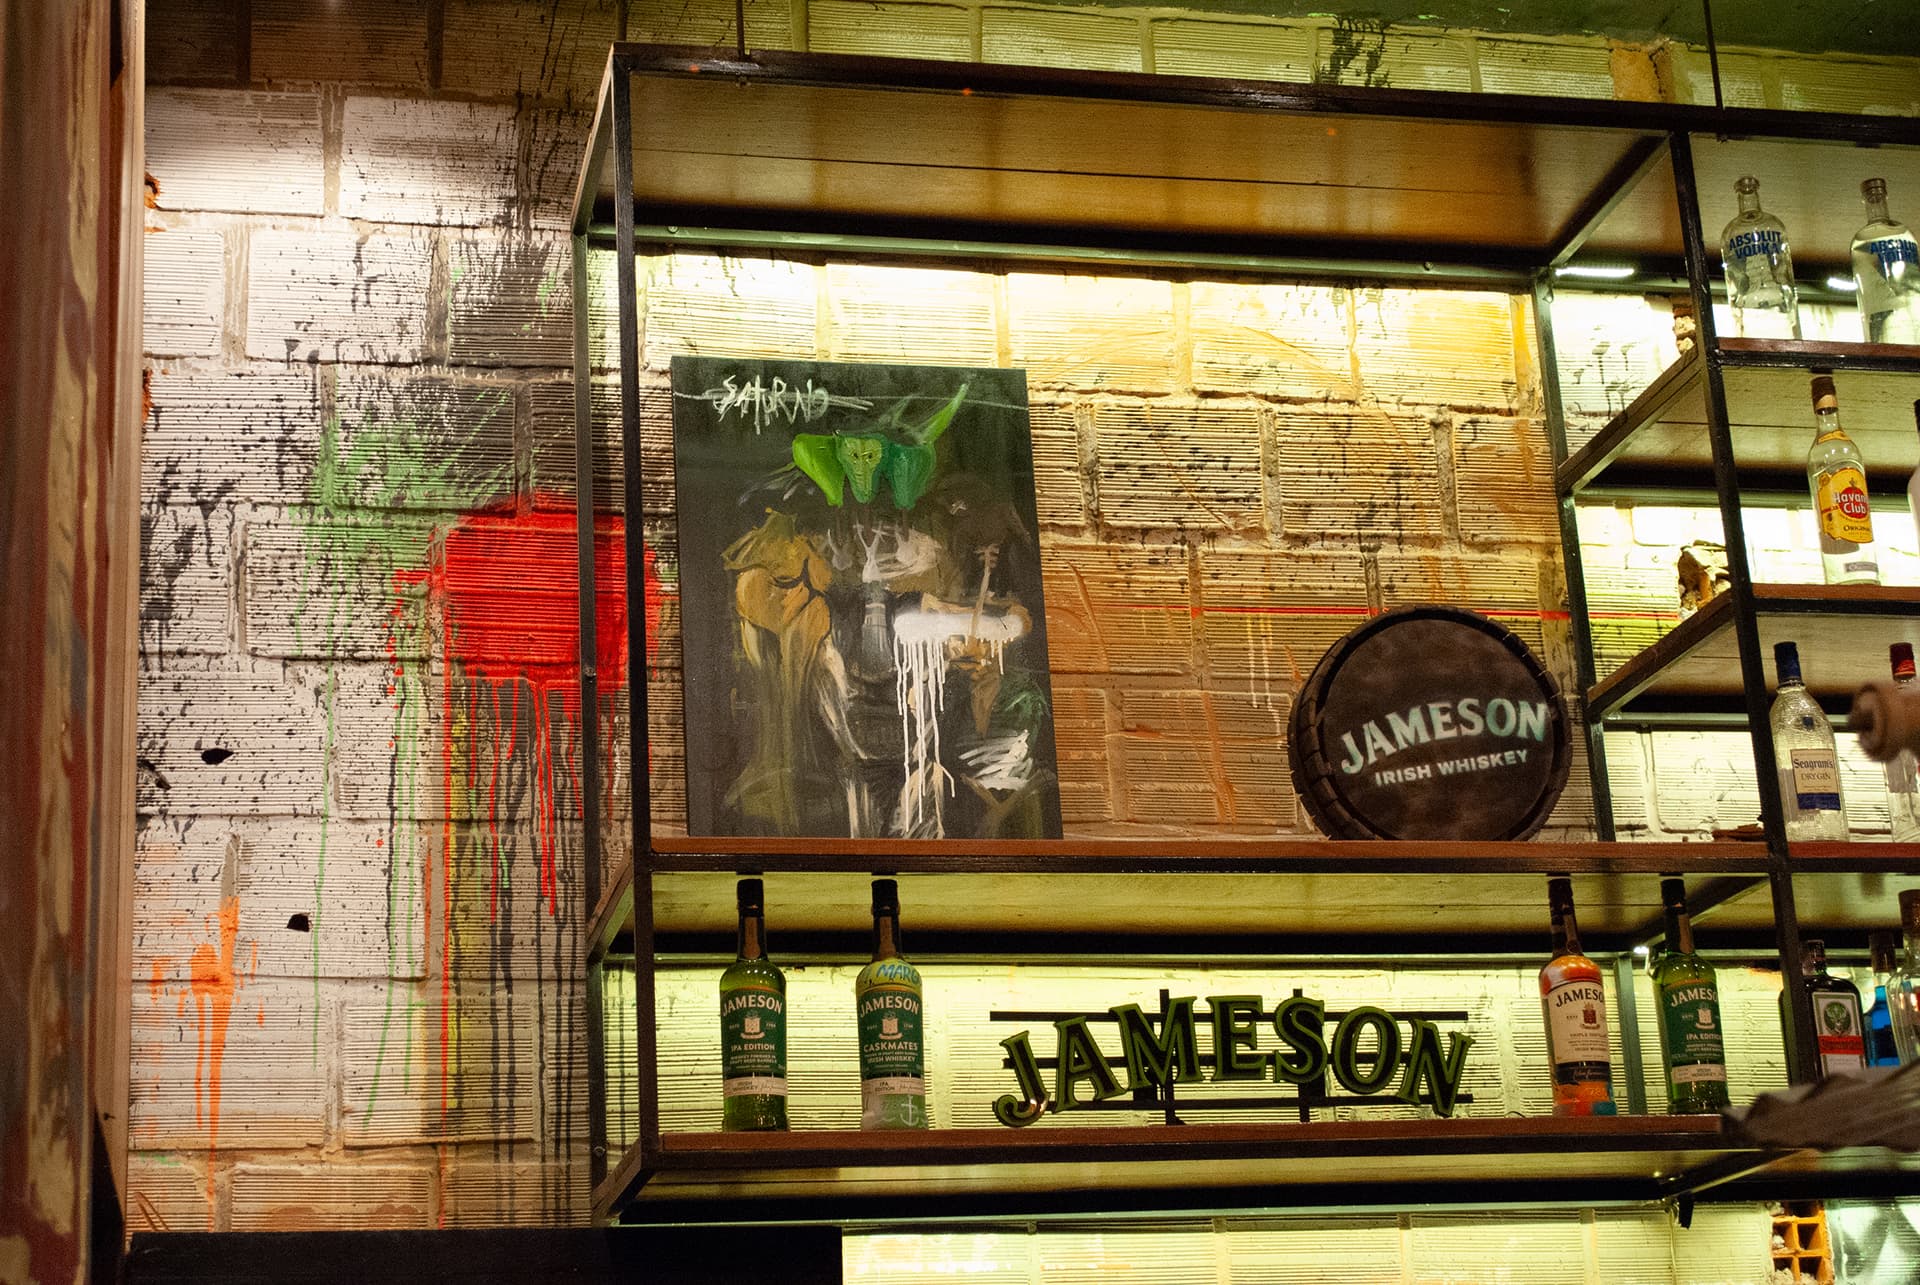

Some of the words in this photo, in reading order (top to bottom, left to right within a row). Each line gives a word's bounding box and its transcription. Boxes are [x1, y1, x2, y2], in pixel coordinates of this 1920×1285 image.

[1729, 231, 1783, 250] ABSOLUT
[1735, 243, 1780, 259] VODKA
[1843, 502, 1867, 514] Club
[1341, 698, 1550, 775] JAMESON
[1375, 764, 1432, 787] IRISH
[1437, 750, 1528, 778] WHISKEY
[1793, 758, 1834, 770] Seagram's
[723, 995, 783, 1017] JAMESON
[861, 996, 919, 1018] JAMESON
[1686, 1033, 1699, 1041] IPA
[743, 1043, 775, 1051] EDITION
[864, 1041, 919, 1053] CASKMATES
[885, 1055, 916, 1063] WHISKEY
[993, 994, 1476, 1128] JAMESON
